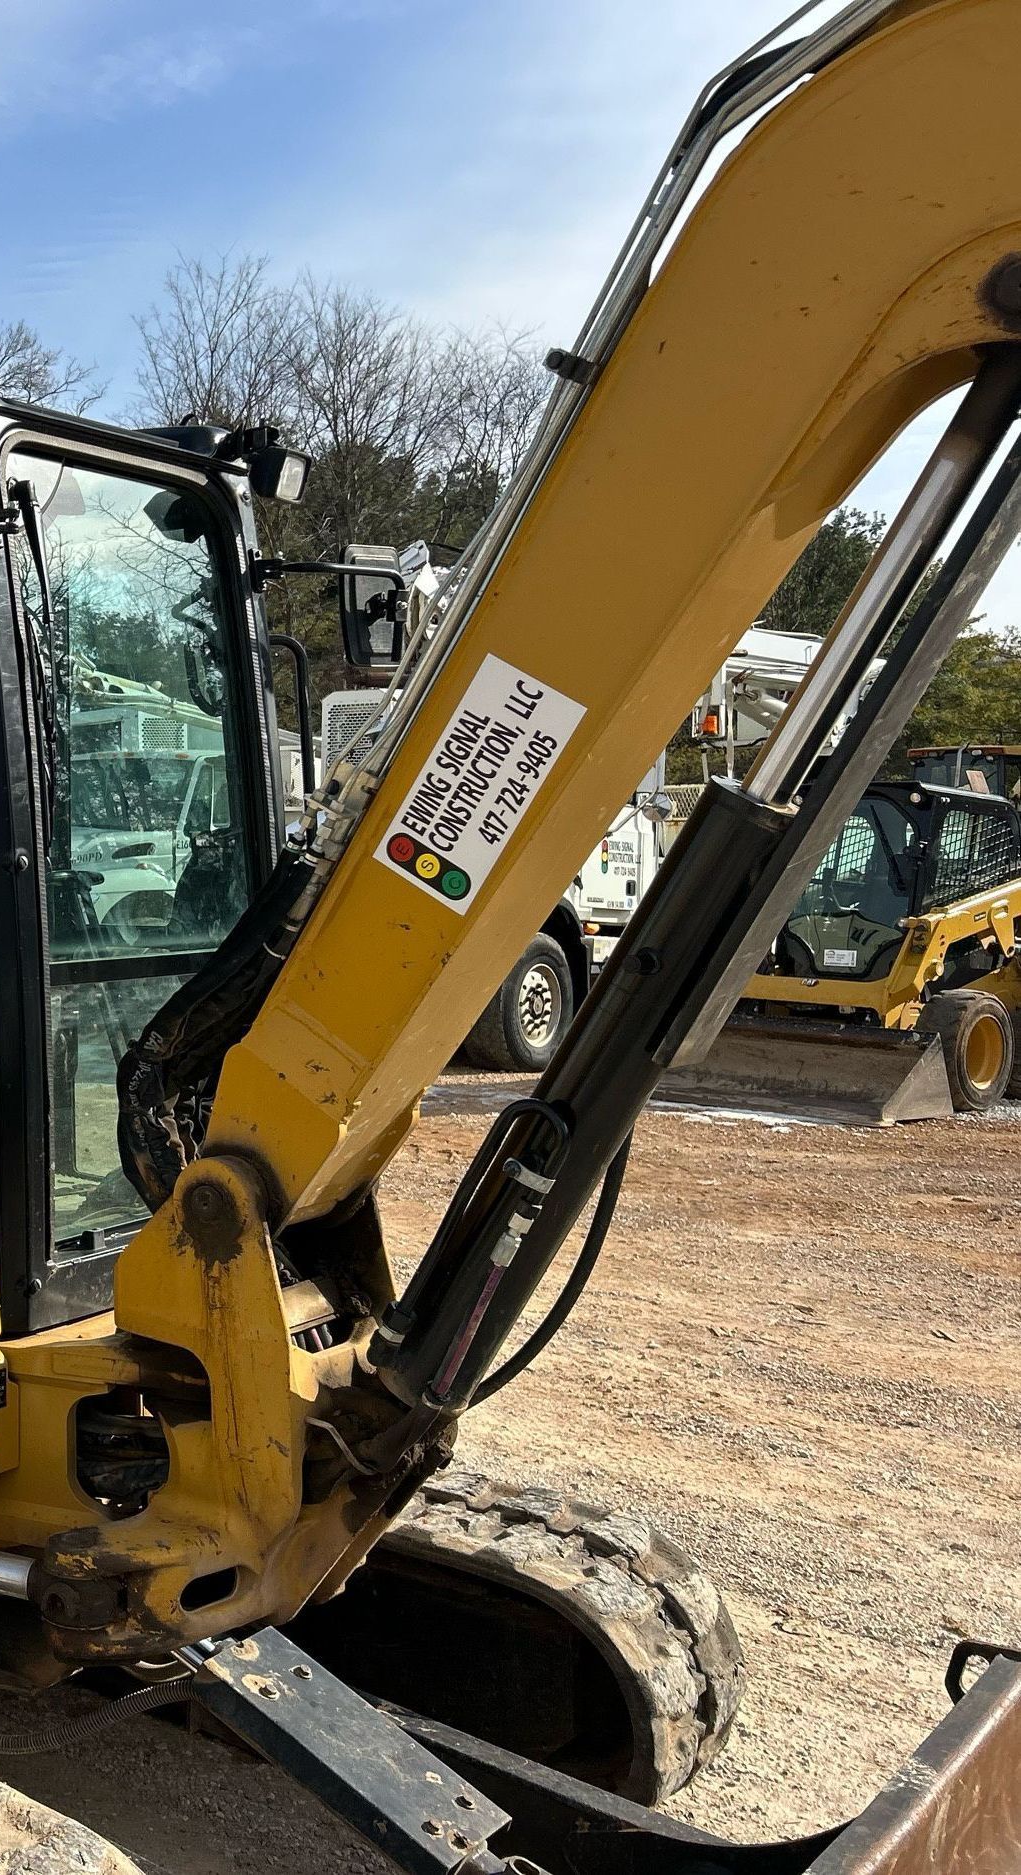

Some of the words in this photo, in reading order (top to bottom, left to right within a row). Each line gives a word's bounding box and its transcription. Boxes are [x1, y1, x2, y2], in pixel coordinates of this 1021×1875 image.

[400, 771, 452, 837] EWING
[435, 710, 491, 777] SIGNAL
[428, 721, 526, 852] CONSTRUCTION,
[504, 679, 544, 720] LLC
[478, 729, 558, 845] 417-724-9405
[144, 1031, 163, 1053] CAT
